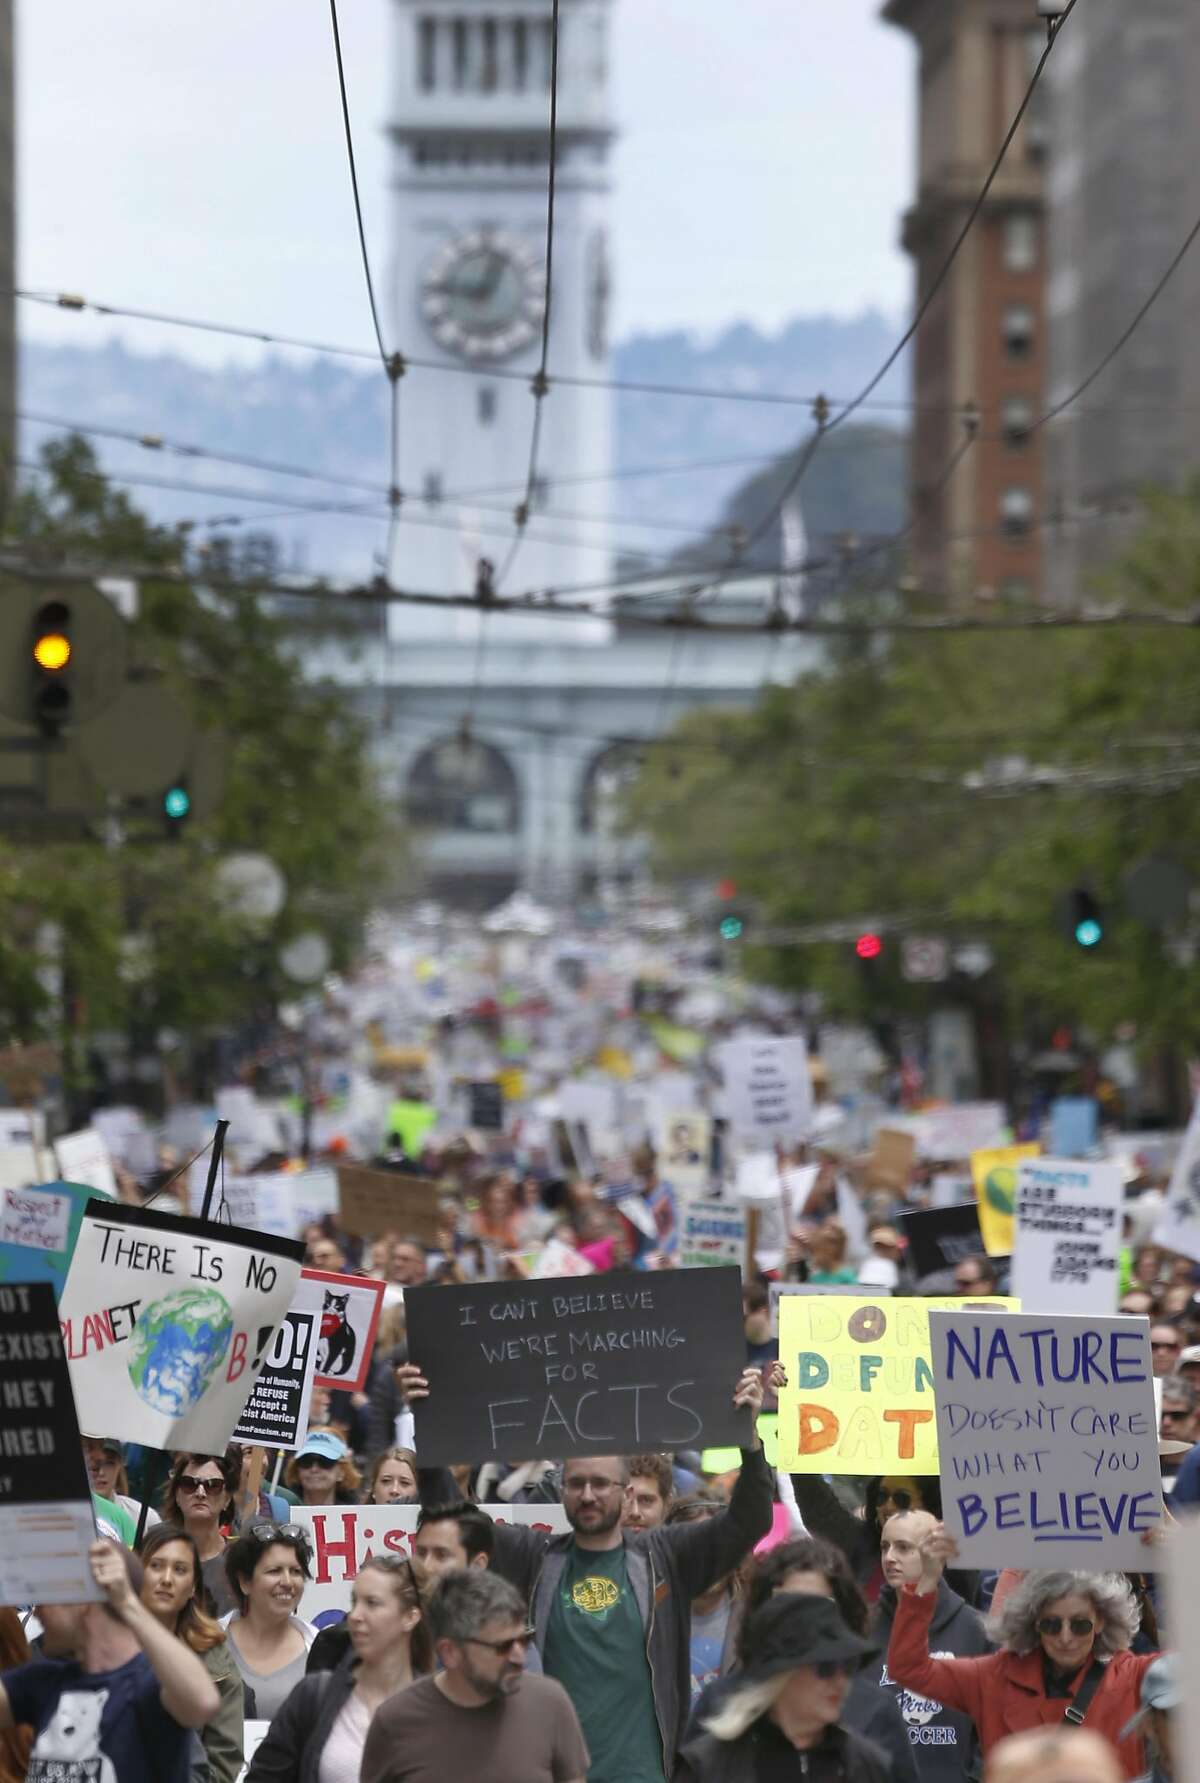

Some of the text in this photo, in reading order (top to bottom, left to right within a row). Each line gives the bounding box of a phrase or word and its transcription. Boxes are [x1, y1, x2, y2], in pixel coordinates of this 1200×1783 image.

[93, 1224, 277, 1293] THERE IS NO
[459, 1305, 477, 1325] I
[552, 1292, 654, 1319] BELIEVE
[480, 1328, 685, 1364] WE'RE MARCHING
[946, 1326, 1147, 1387] NATURE
[545, 1363, 599, 1385] FOR
[250, 1398, 288, 1411] Accept a
[256, 1387, 289, 1400] REFUSE
[260, 1411, 296, 1424] America
[488, 1382, 702, 1449] FACTS
[798, 1403, 943, 1459] DAT
[943, 1400, 1149, 1437] DOESN'T CARE
[953, 1449, 1140, 1480] WHAT YOU
[957, 1491, 1161, 1537] BELIEVE
